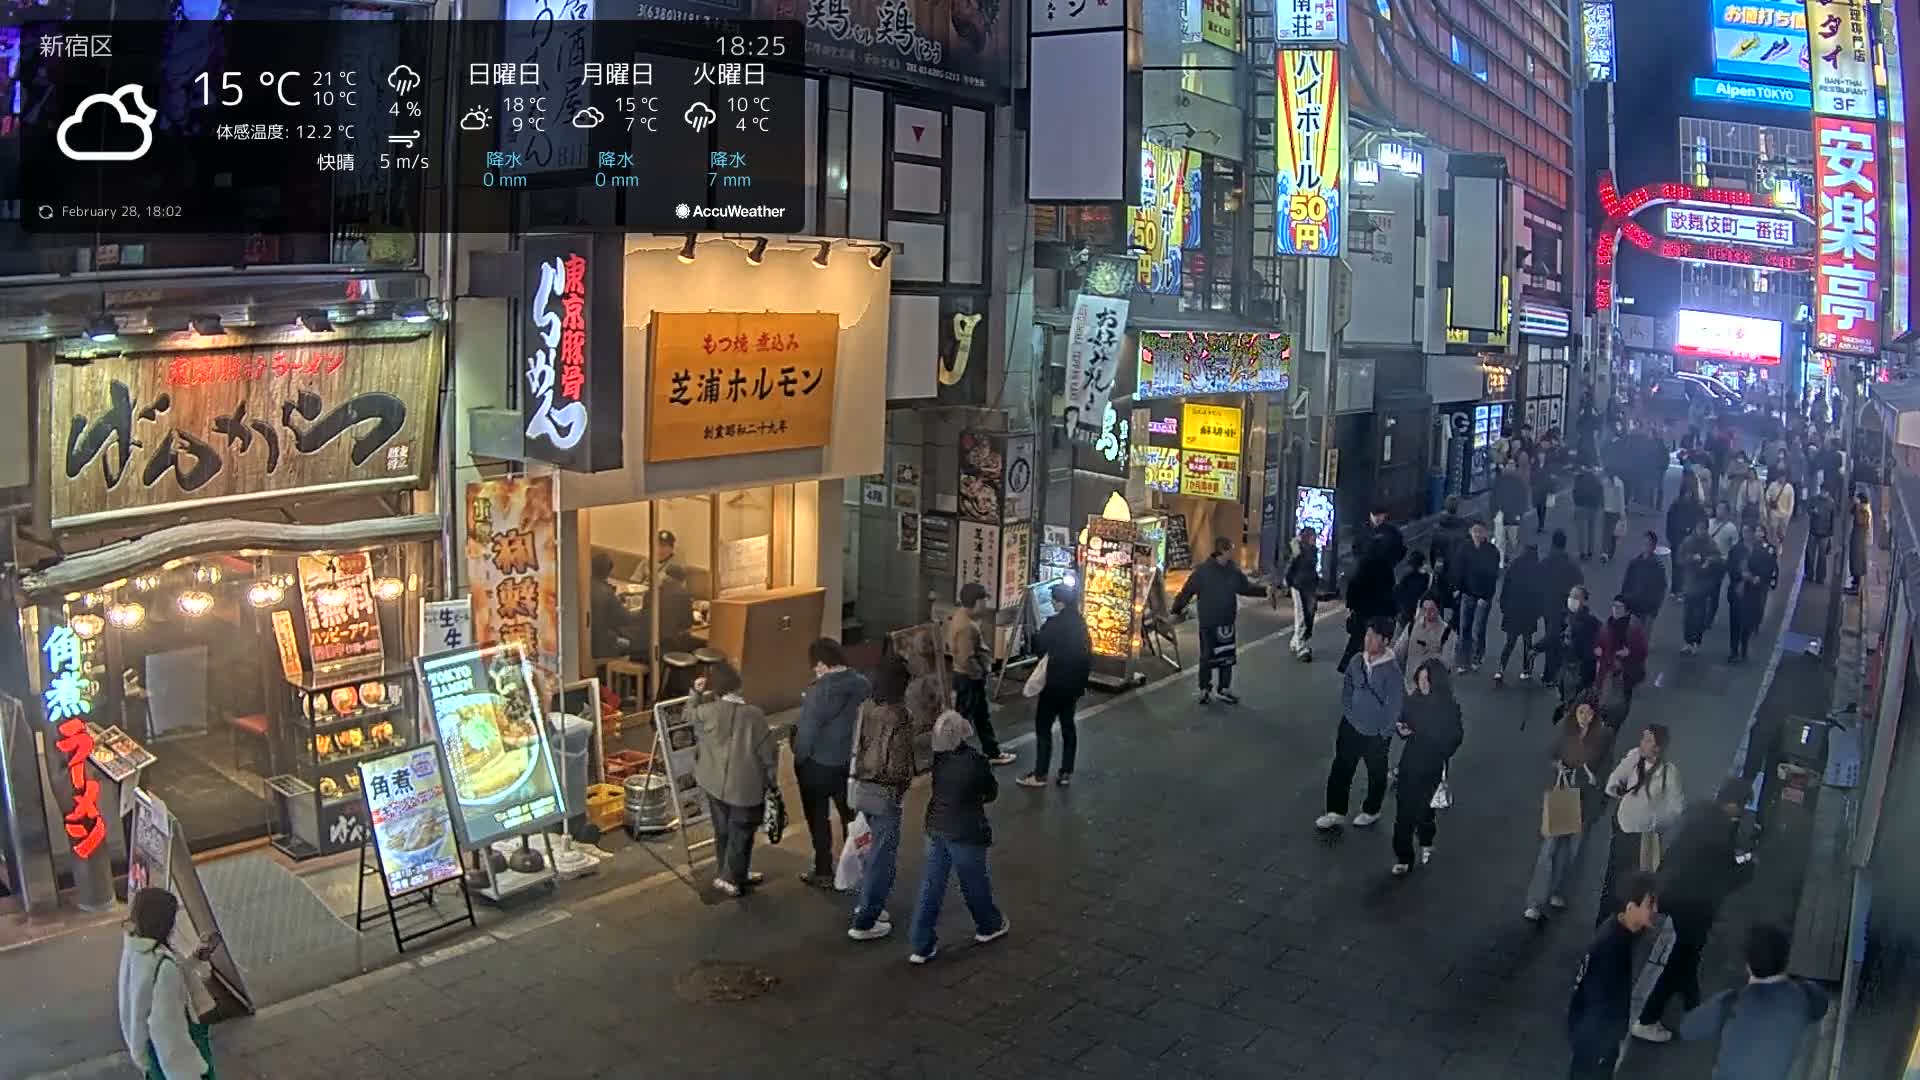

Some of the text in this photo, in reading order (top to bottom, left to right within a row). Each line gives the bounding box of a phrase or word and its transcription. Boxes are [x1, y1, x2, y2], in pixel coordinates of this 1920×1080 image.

[1716, 82, 1794, 100] Alpen TOKYO
[1833, 97, 1857, 111] 3F
[1296, 54, 1322, 190] ハイボール
[1289, 195, 1327, 222] 50
[1294, 223, 1321, 251] 円
[1671, 211, 1789, 242] 歌舞伎町一番街
[1818, 125, 1877, 330] 安楽亭
[561, 253, 588, 401] 東京豚骨
[1818, 333, 1838, 349] 2F
[703, 331, 800, 354] もつ焼 煮込み
[669, 366, 824, 405] 芝浦ホルモン
[703, 420, 789, 440] 創業昭和二十九年
[370, 768, 415, 801] 角煮
